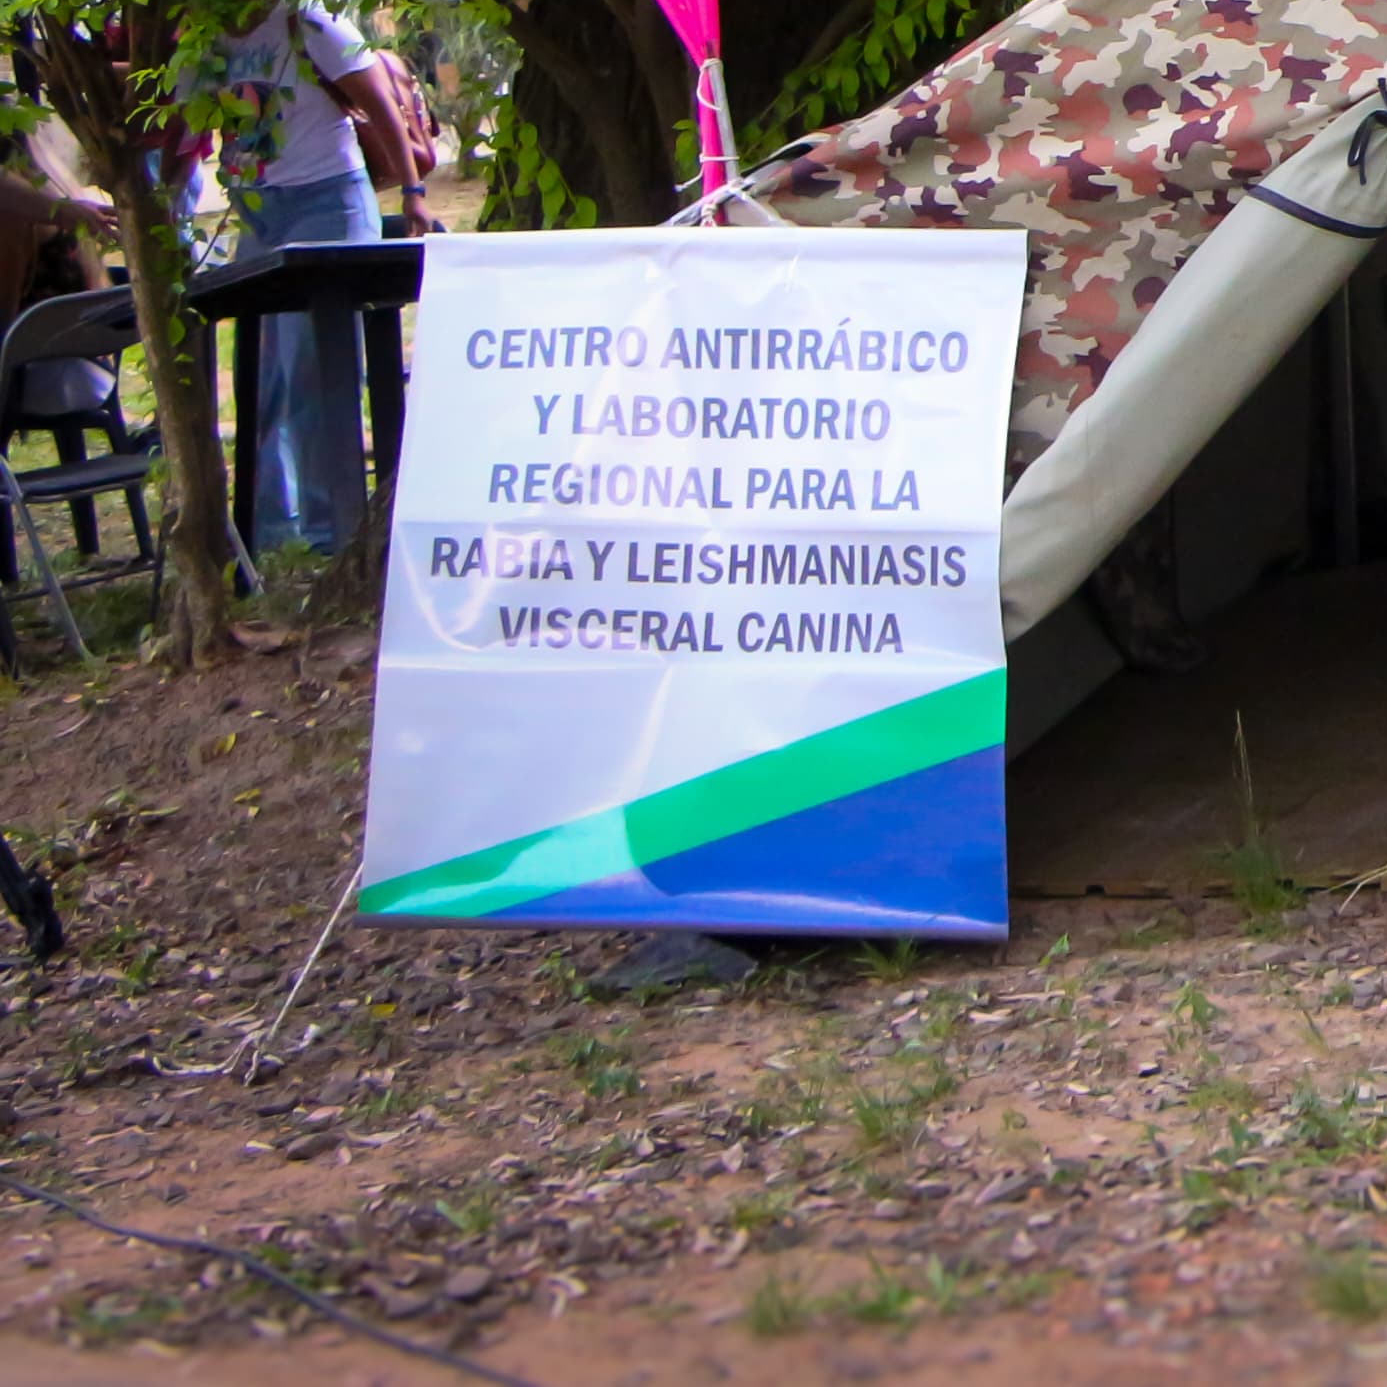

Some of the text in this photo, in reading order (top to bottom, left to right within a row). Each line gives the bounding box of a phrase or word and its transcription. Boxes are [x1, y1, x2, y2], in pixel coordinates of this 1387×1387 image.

[465, 318, 969, 373] CENTRO ANTIRRÁBICO
[532, 394, 891, 441] Y LABORATORIO
[488, 463, 921, 512] REGIONAL PARA LA
[430, 537, 967, 587] RABIA Y LEISHMANIASIS
[498, 605, 904, 654] VISCERAL CANINA
